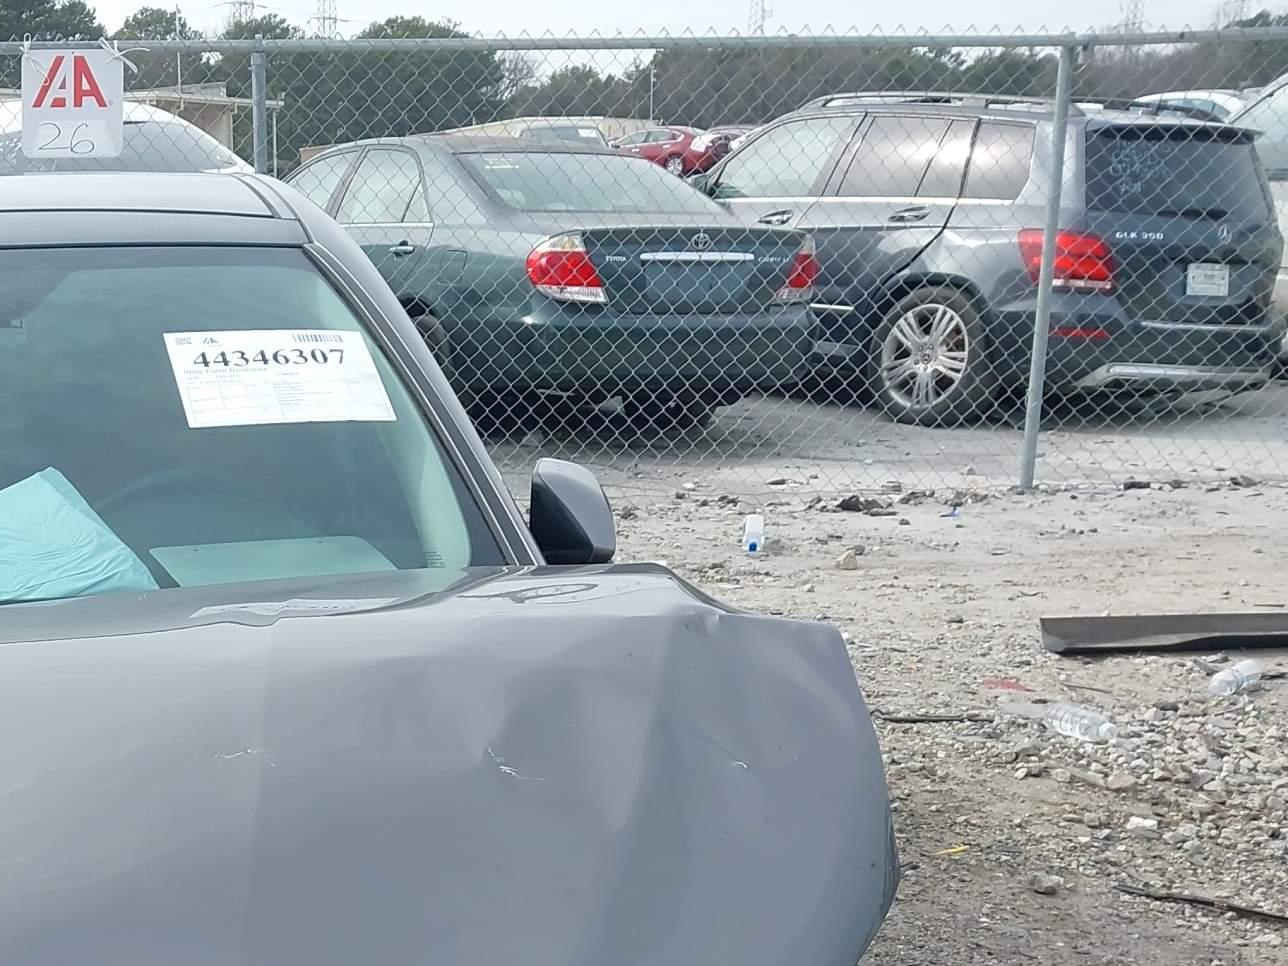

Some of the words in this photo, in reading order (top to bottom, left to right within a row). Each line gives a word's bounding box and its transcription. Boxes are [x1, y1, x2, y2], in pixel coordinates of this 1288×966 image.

[38, 121, 95, 155] 26
[1115, 231, 1138, 239] GLK
[193, 347, 344, 368] 44346307
